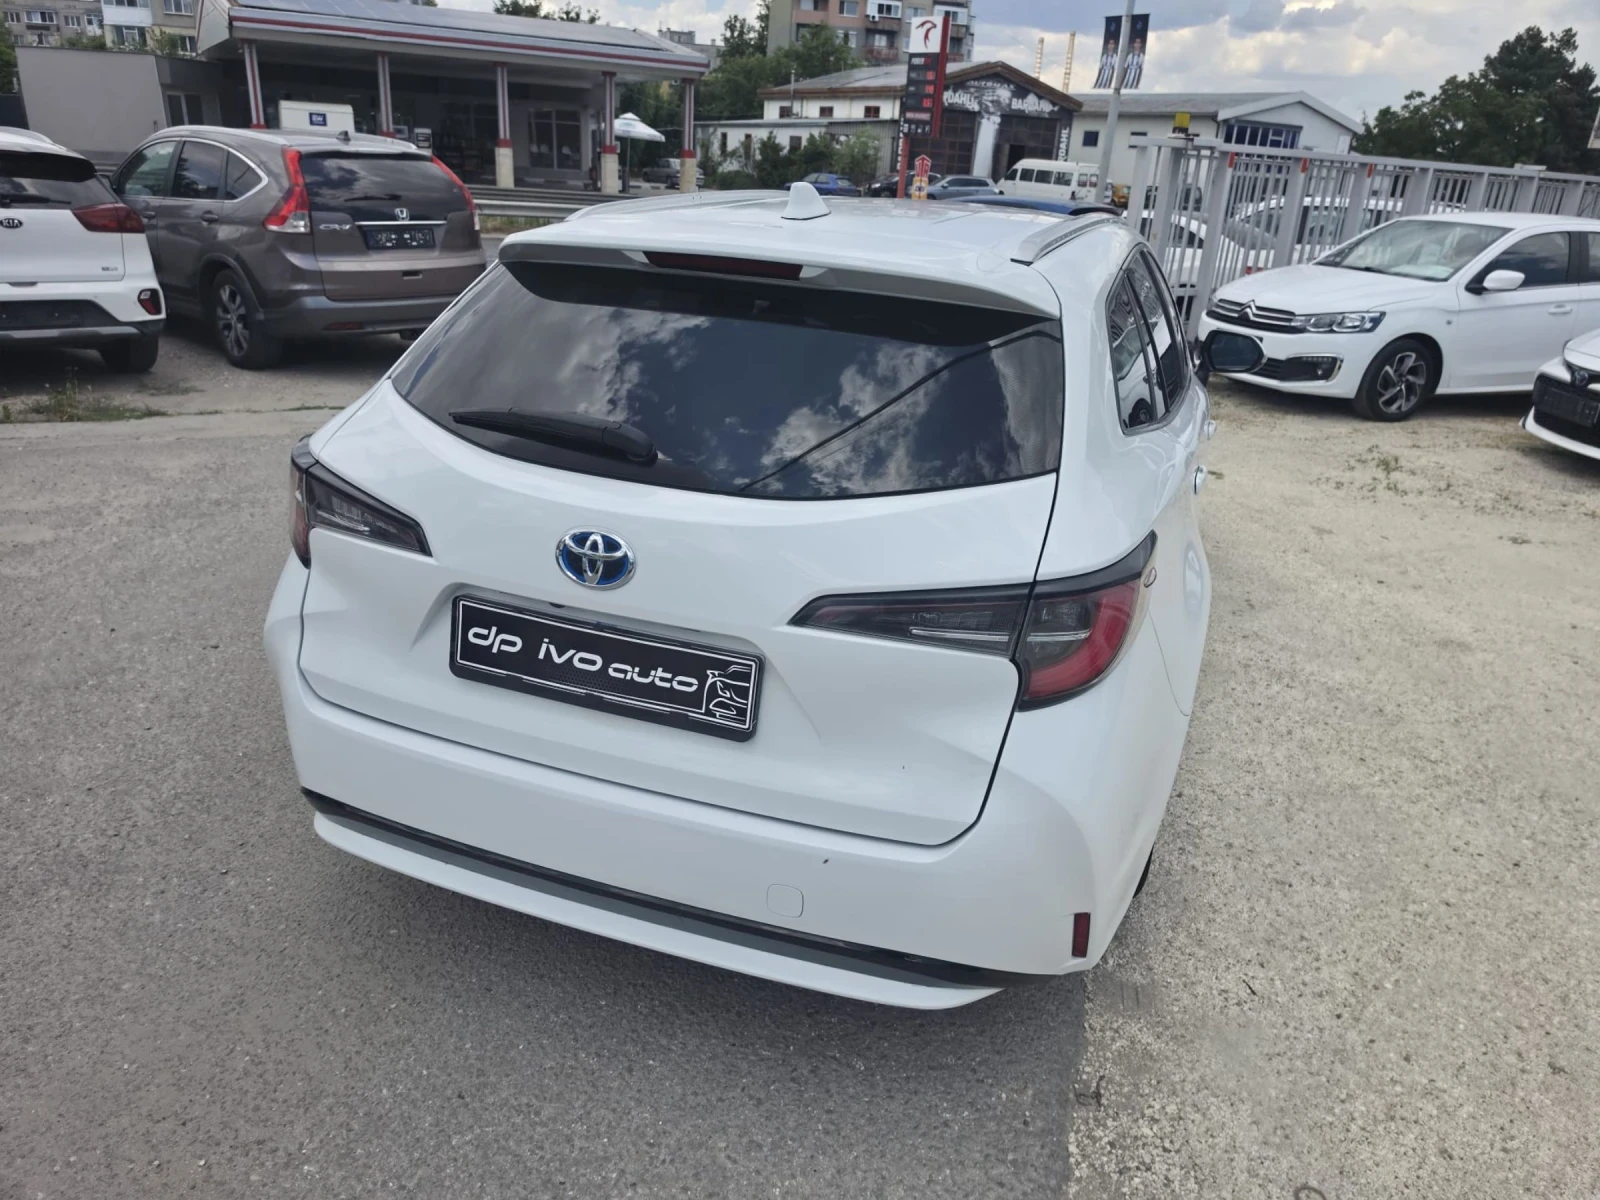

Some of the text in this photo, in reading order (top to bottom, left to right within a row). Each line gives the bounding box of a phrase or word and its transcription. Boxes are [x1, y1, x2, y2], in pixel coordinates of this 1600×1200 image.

[2, 219, 20, 227] KIA
[467, 626, 699, 692] dp ivo auto
